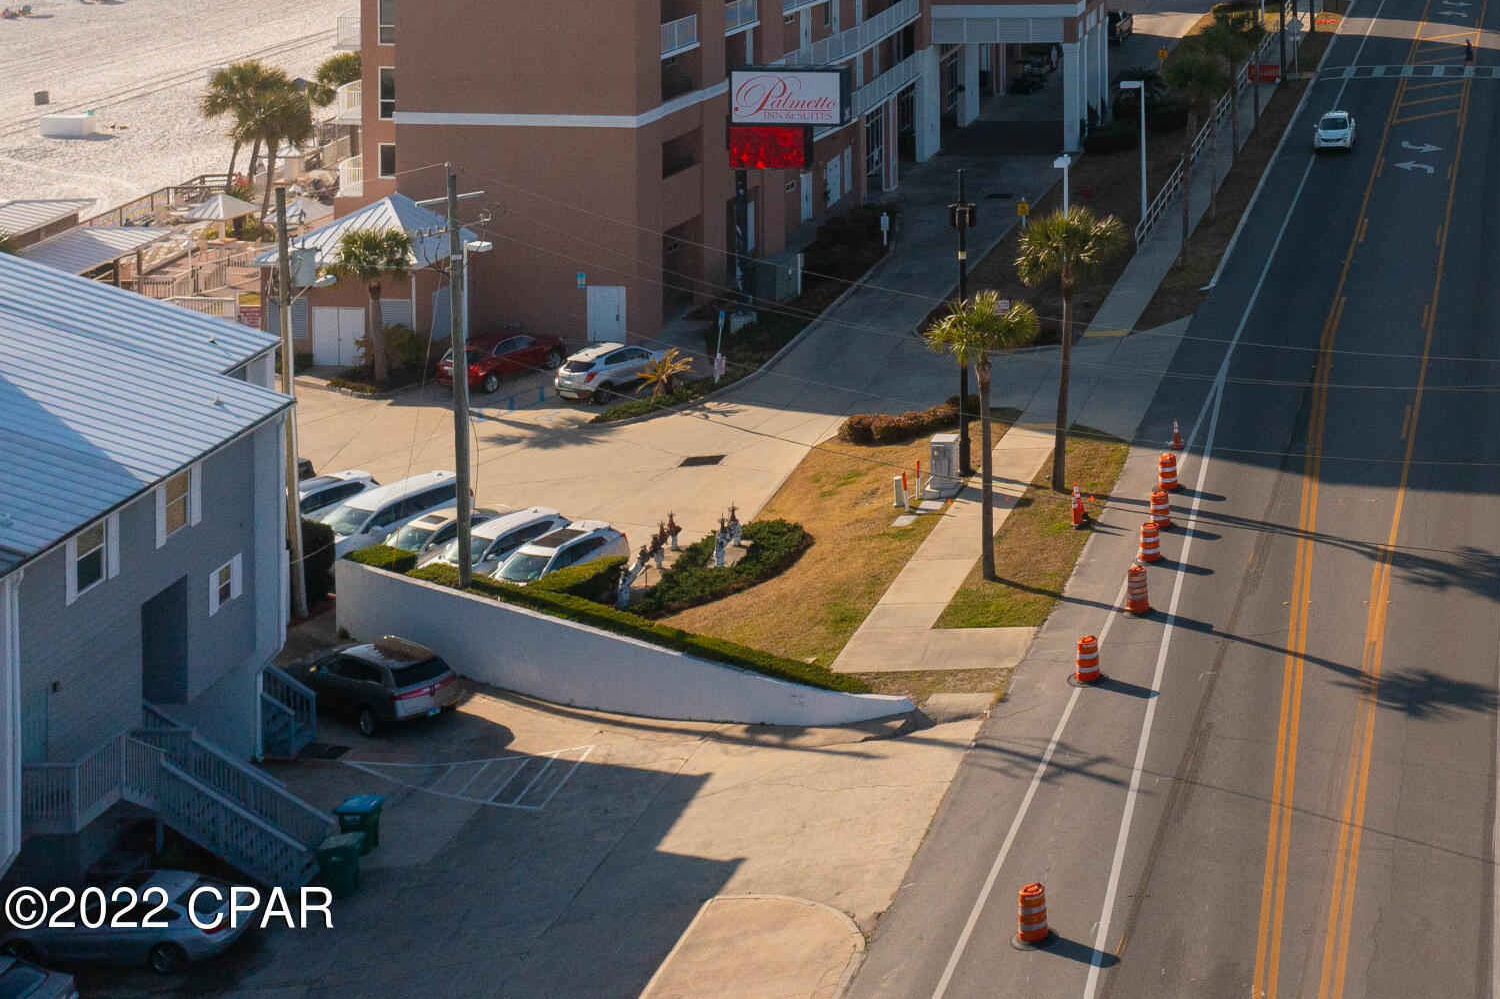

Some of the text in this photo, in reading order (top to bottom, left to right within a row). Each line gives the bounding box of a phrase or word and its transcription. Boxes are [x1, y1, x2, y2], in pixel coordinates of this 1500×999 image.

[734, 75, 837, 118] Palmetto
[763, 111, 833, 120] INN & SUITES
